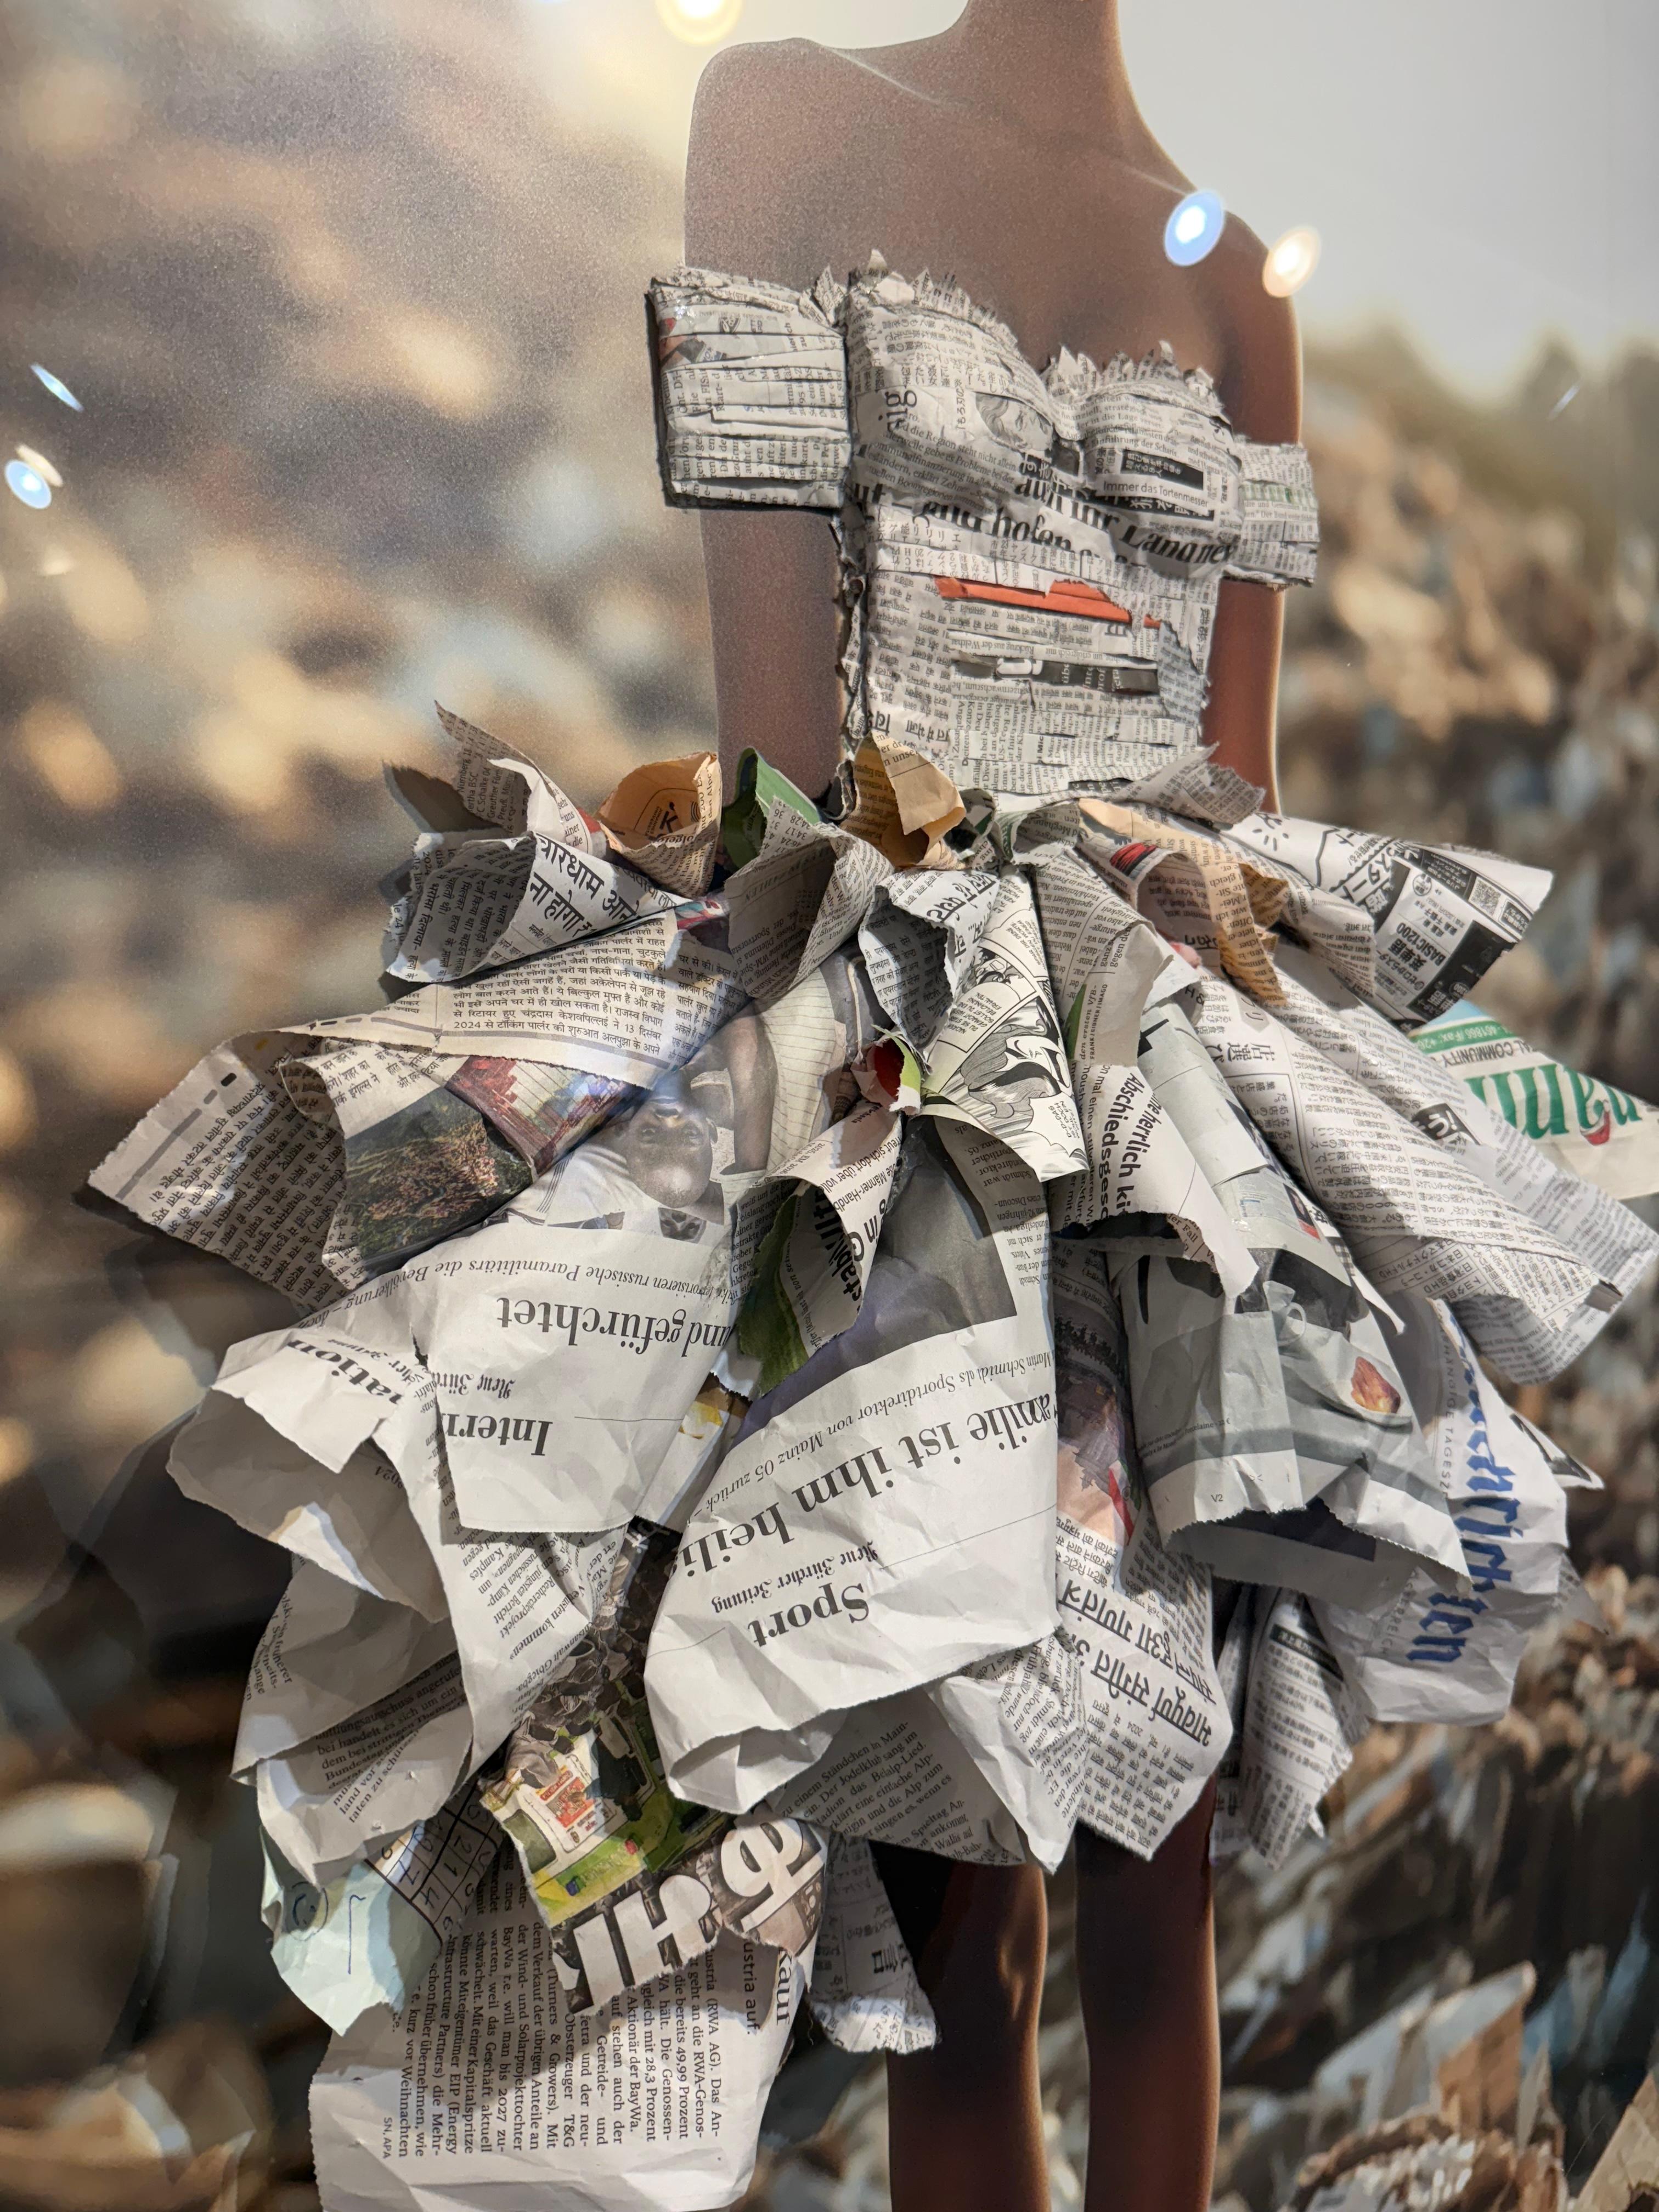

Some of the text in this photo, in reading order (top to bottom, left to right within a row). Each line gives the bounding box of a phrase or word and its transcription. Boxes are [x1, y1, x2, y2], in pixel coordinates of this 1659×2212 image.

[1103, 477, 1209, 506] Immer das Tortenmesser
[469, 772, 478, 787] BSC
[477, 777, 488, 805] Schalke
[545, 890, 585, 932] होगा
[1110, 944, 1125, 967] gegen
[1393, 923, 1445, 965] BASIC1200
[453, 991, 471, 1000] लोग
[496, 988, 516, 996] करने
[634, 995, 648, 1008] और
[486, 997, 507, 1007] अपने
[575, 1002, 599, 1012] सकता
[590, 978, 627, 990] अकेलेपन
[454, 1021, 481, 1029] 2024
[484, 1019, 494, 1029] से
[527, 1020, 550, 1031] पार्लर
[554, 1022, 565, 1032] की
[644, 1042, 661, 1057] अपने
[469, 1009, 497, 1018] रिटायर
[503, 1009, 516, 1020] हुए
[625, 1024, 635, 1034] 13
[1440, 1042, 1513, 1067] COMMUNITY
[1086, 1097, 1097, 1130] einen
[836, 1145, 885, 1181] sich dort über
[1118, 1111, 1162, 1177] herrlich
[435, 1260, 463, 1277] die
[470, 1259, 582, 1282] Paramilitärs
[585, 1265, 649, 1288] russische
[496, 1297, 687, 1355] gefürchtet
[960, 1372, 974, 1387] als
[977, 1357, 1025, 1385] Schmidt
[857, 1373, 956, 1420] Sportdirektor
[827, 1414, 854, 1436] von
[967, 1392, 1057, 1450] amilie
[778, 1430, 824, 1464] Mainz
[898, 1421, 961, 1469] ist
[706, 1472, 751, 1513] zurück
[755, 1459, 775, 1482] 05
[792, 1447, 894, 1513] ihm
[1211, 1493, 1223, 1503] V2
[470, 1548, 504, 1580] Kampfes
[711, 1539, 878, 1613] Neue Zürcher Zeitung
[493, 1565, 543, 1623] jüngsten Bericht
[747, 1582, 870, 1647] Sport
[510, 1618, 554, 1660] kommen»
[1135, 1623, 1186, 1668] हुआ
[1081, 1650, 1149, 1706] संगीत
[794, 1722, 907, 1806] einem Ständchen Main-
[742, 1940, 760, 2035] ustria auf.
[445, 1934, 472, 2154] könnte Miteigentümer (Energy
[463, 1931, 486, 2154] schwächelt. einer Kapitalspritze
[479, 1929, 499, 2153] warten, Geschäft aktuell
[496, 1926, 514, 2122] BayWa 2027
[528, 1951, 545, 2130] Verkauf übrigen Anteile
[512, 1948, 529, 2151] Wind- Solarprojekttochter
[546, 1969, 560, 2148] (Turners Growers). Mit
[627, 1995, 641, 2132] Aktionär der BayWa.
[659, 2000, 673, 2141] hält. Die Genossen-
[674, 1974, 690, 2139] die bereits 49,99 Prozent
[414, 2040, 432, 2130] übernehmen,
[431, 2023, 450, 2155] Partners) Mehr-
[561, 2012, 576, 2148] Obsterzeuger T&G
[595, 2035, 607, 2146] Getreide- und
[612, 2024, 624, 2144] stehen auch der
[692, 2025, 707, 2138] die RWA-Genos-
[710, 2078, 721, 2103] Das
[398, 2066, 413, 2157] Weihnachten
[646, 2087, 658, 2142] Prozent
